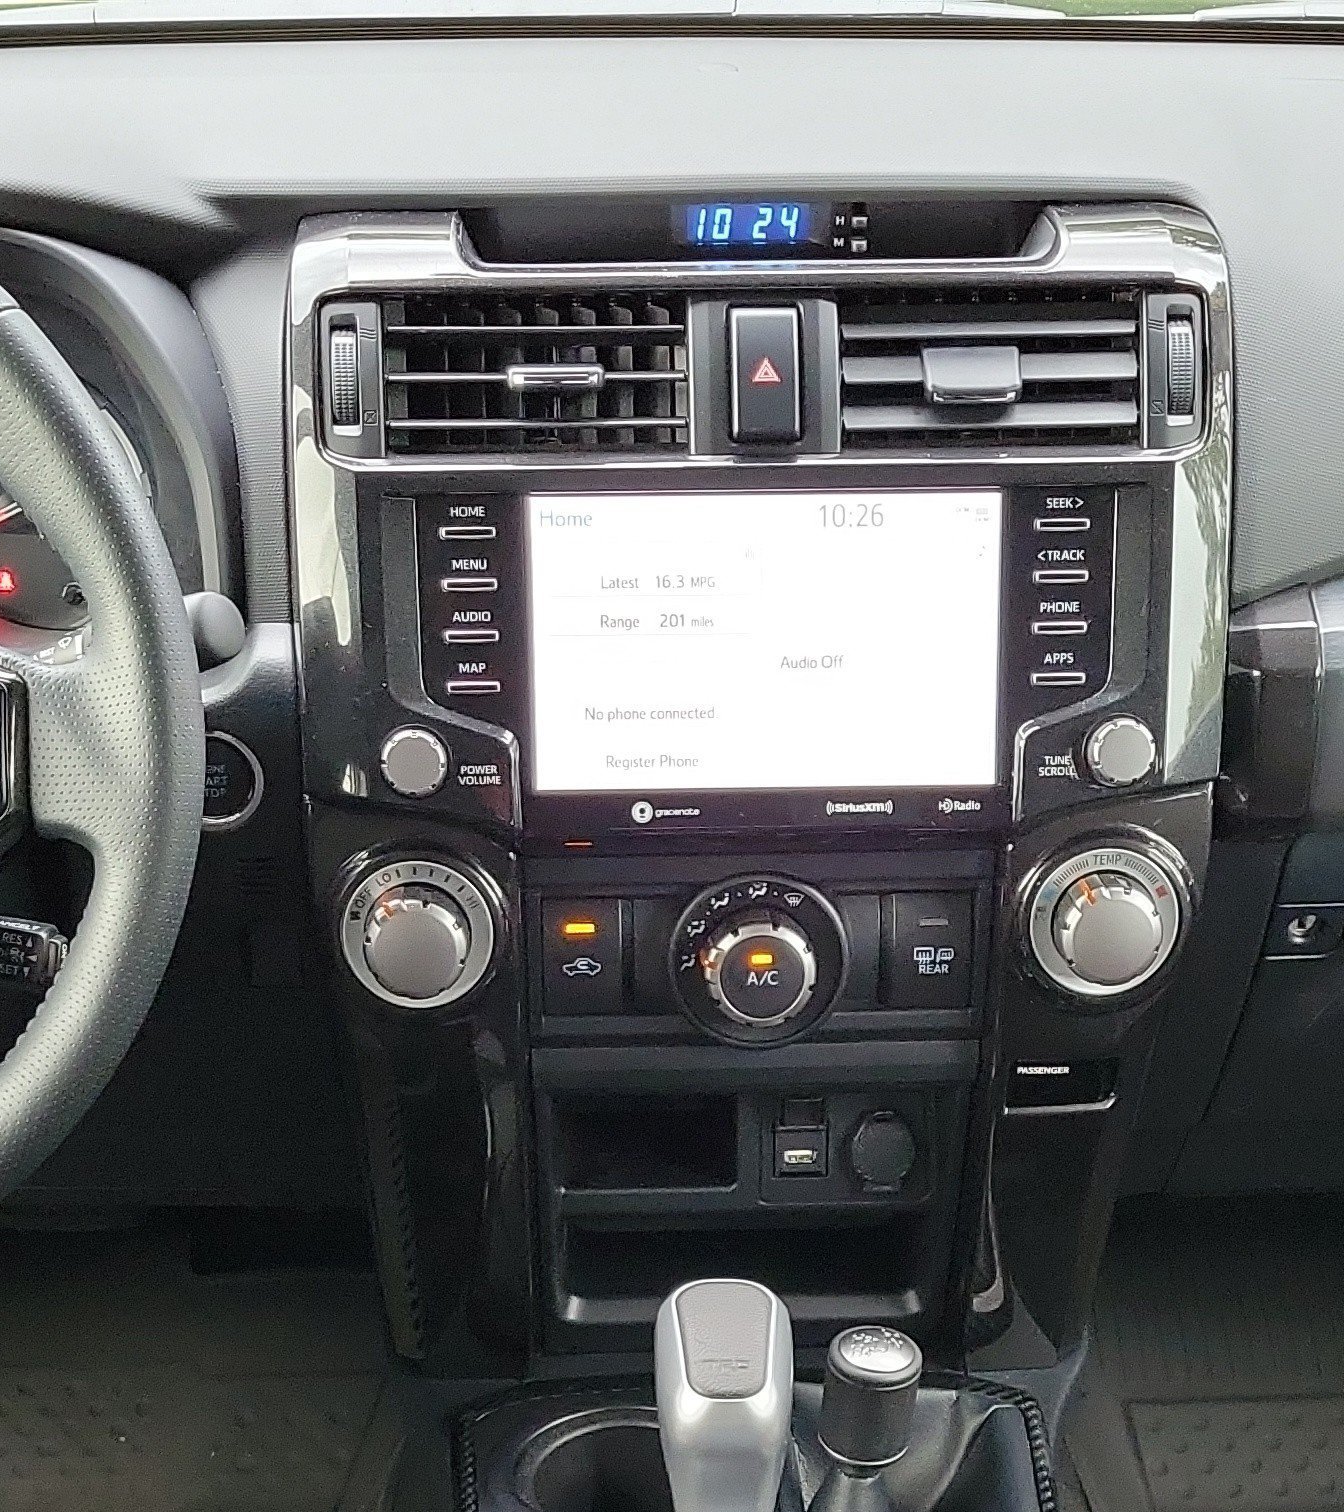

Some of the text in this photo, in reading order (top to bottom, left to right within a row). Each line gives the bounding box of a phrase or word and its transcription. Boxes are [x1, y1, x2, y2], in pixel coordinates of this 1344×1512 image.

[835, 215, 845, 226] H
[833, 236, 845, 247] M
[449, 505, 486, 519] HOME
[539, 508, 594, 528] Home
[818, 503, 885, 528] 10:26
[450, 558, 488, 571] MENU
[600, 575, 717, 590] Latest 16.3 MPG
[1039, 601, 1081, 614] PHONE
[452, 610, 492, 623] AUDIO
[599, 613, 715, 630] Range 201 miles
[780, 654, 845, 670] Audio Off
[1043, 652, 1075, 665] APPS
[457, 661, 487, 674] MAP
[584, 706, 605, 721] No
[607, 706, 647, 723] phone
[605, 754, 700, 772] Register Phone
[1043, 754, 1071, 766] TUNE
[460, 764, 499, 776] POWER
[1037, 765, 1076, 778] SCROLL
[457, 774, 502, 786] VOLUME
[953, 800, 981, 811] Radio
[1092, 854, 1122, 867] TEMP
[375, 872, 392, 887] LO
[918, 963, 950, 975] REAR
[746, 970, 779, 987] A/C
[1016, 1065, 1070, 1075] PASSENGER
